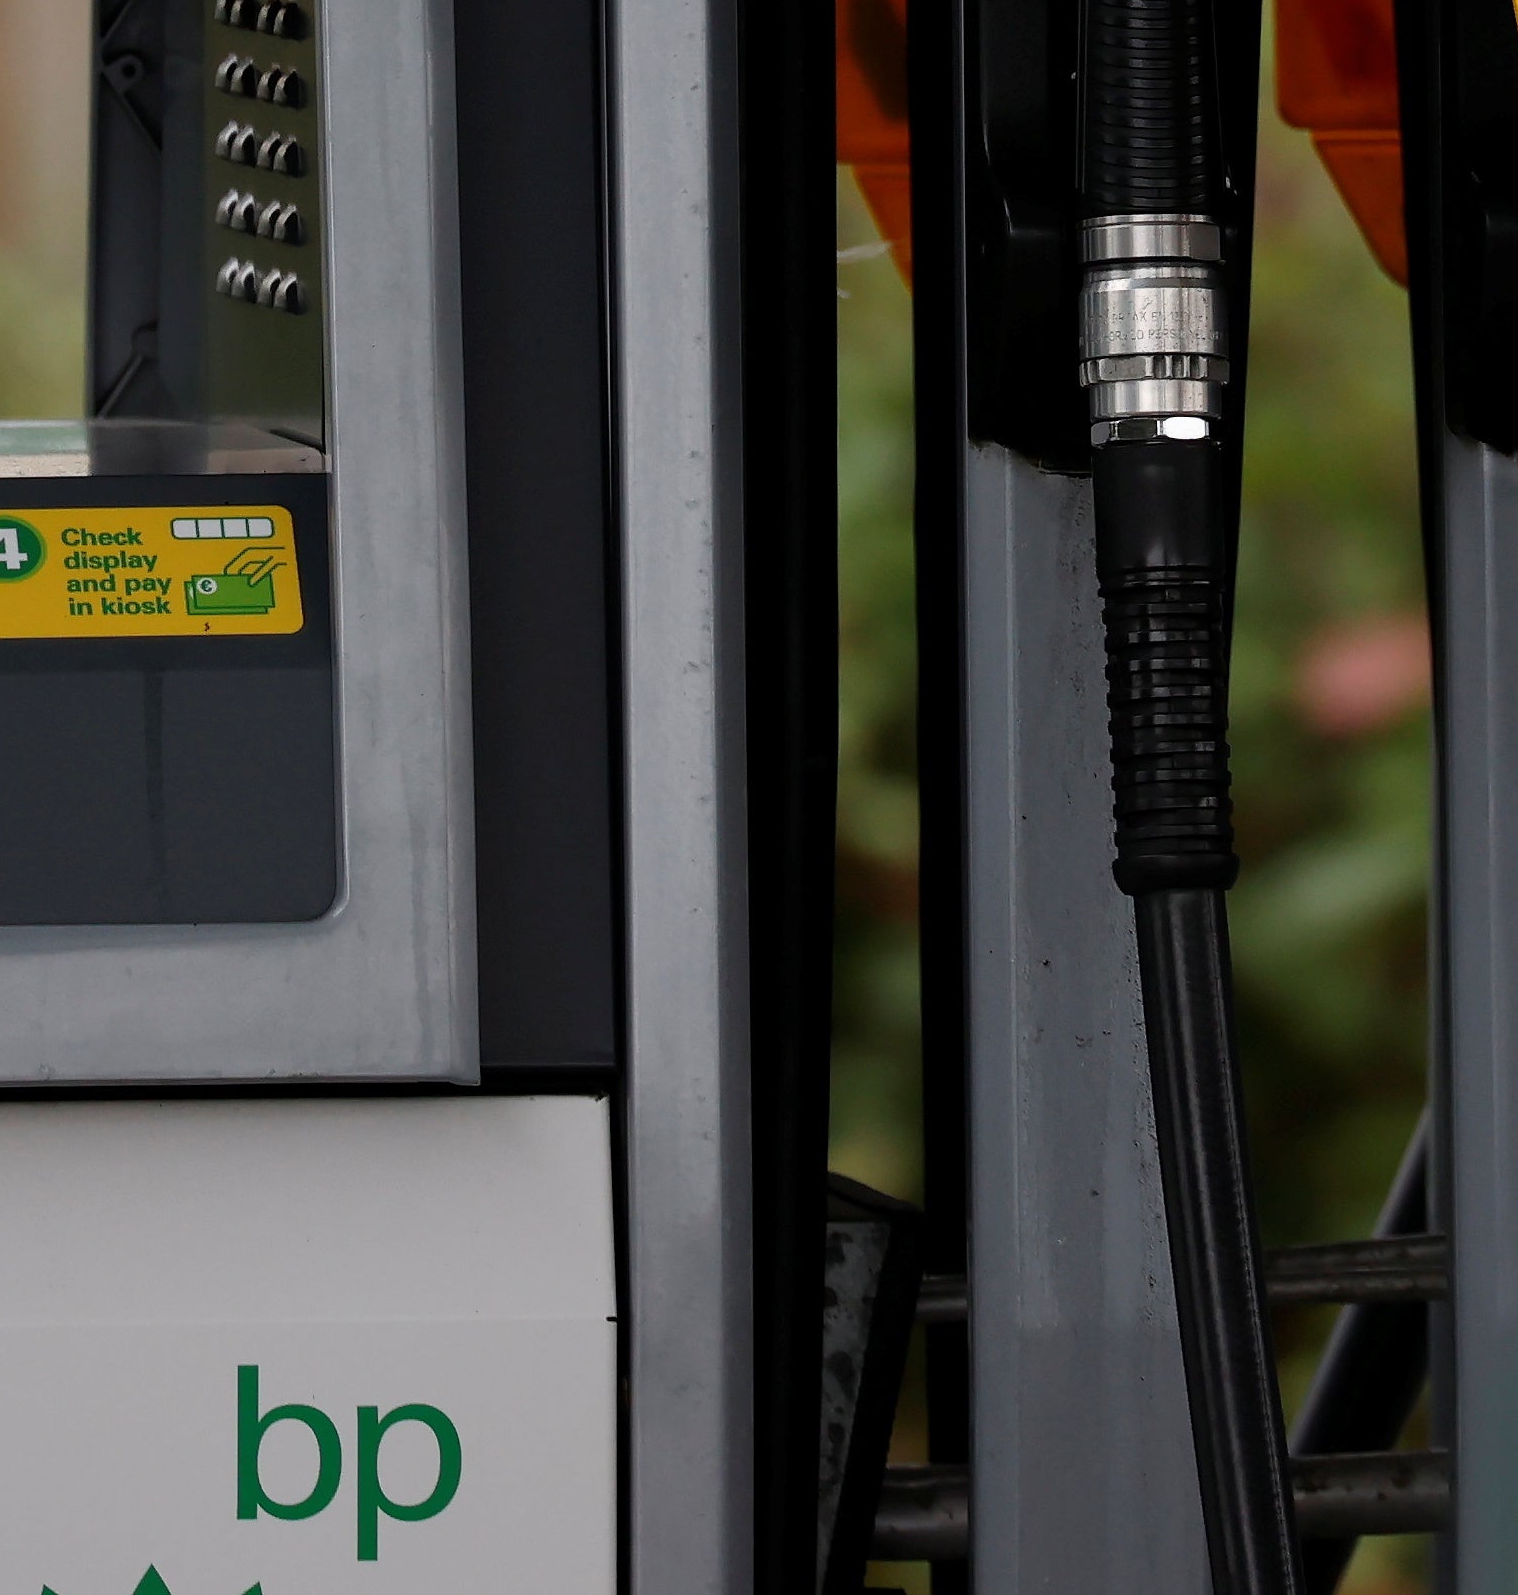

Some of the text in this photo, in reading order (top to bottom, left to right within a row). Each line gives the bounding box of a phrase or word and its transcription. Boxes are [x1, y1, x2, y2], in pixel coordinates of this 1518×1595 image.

[61, 528, 143, 546] Check
[64, 550, 157, 572] display
[67, 574, 171, 598] and pay
[69, 596, 172, 615] in kiosk
[237, 1365, 461, 1561] bp
